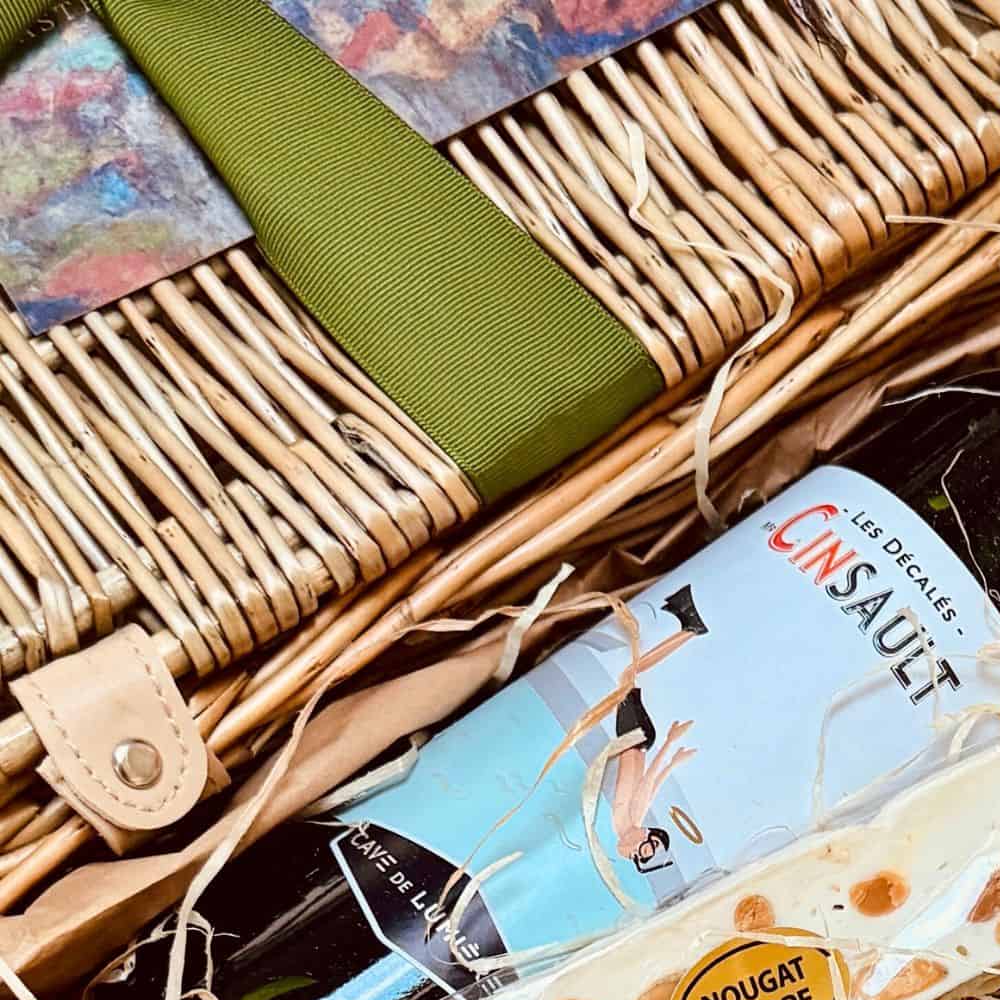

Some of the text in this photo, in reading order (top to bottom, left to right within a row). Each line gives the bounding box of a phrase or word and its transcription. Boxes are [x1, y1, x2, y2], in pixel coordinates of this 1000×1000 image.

[850, 511, 958, 623] LES DÉCALÉS
[351, 832, 398, 873] CAVE
[389, 871, 414, 895] DE
